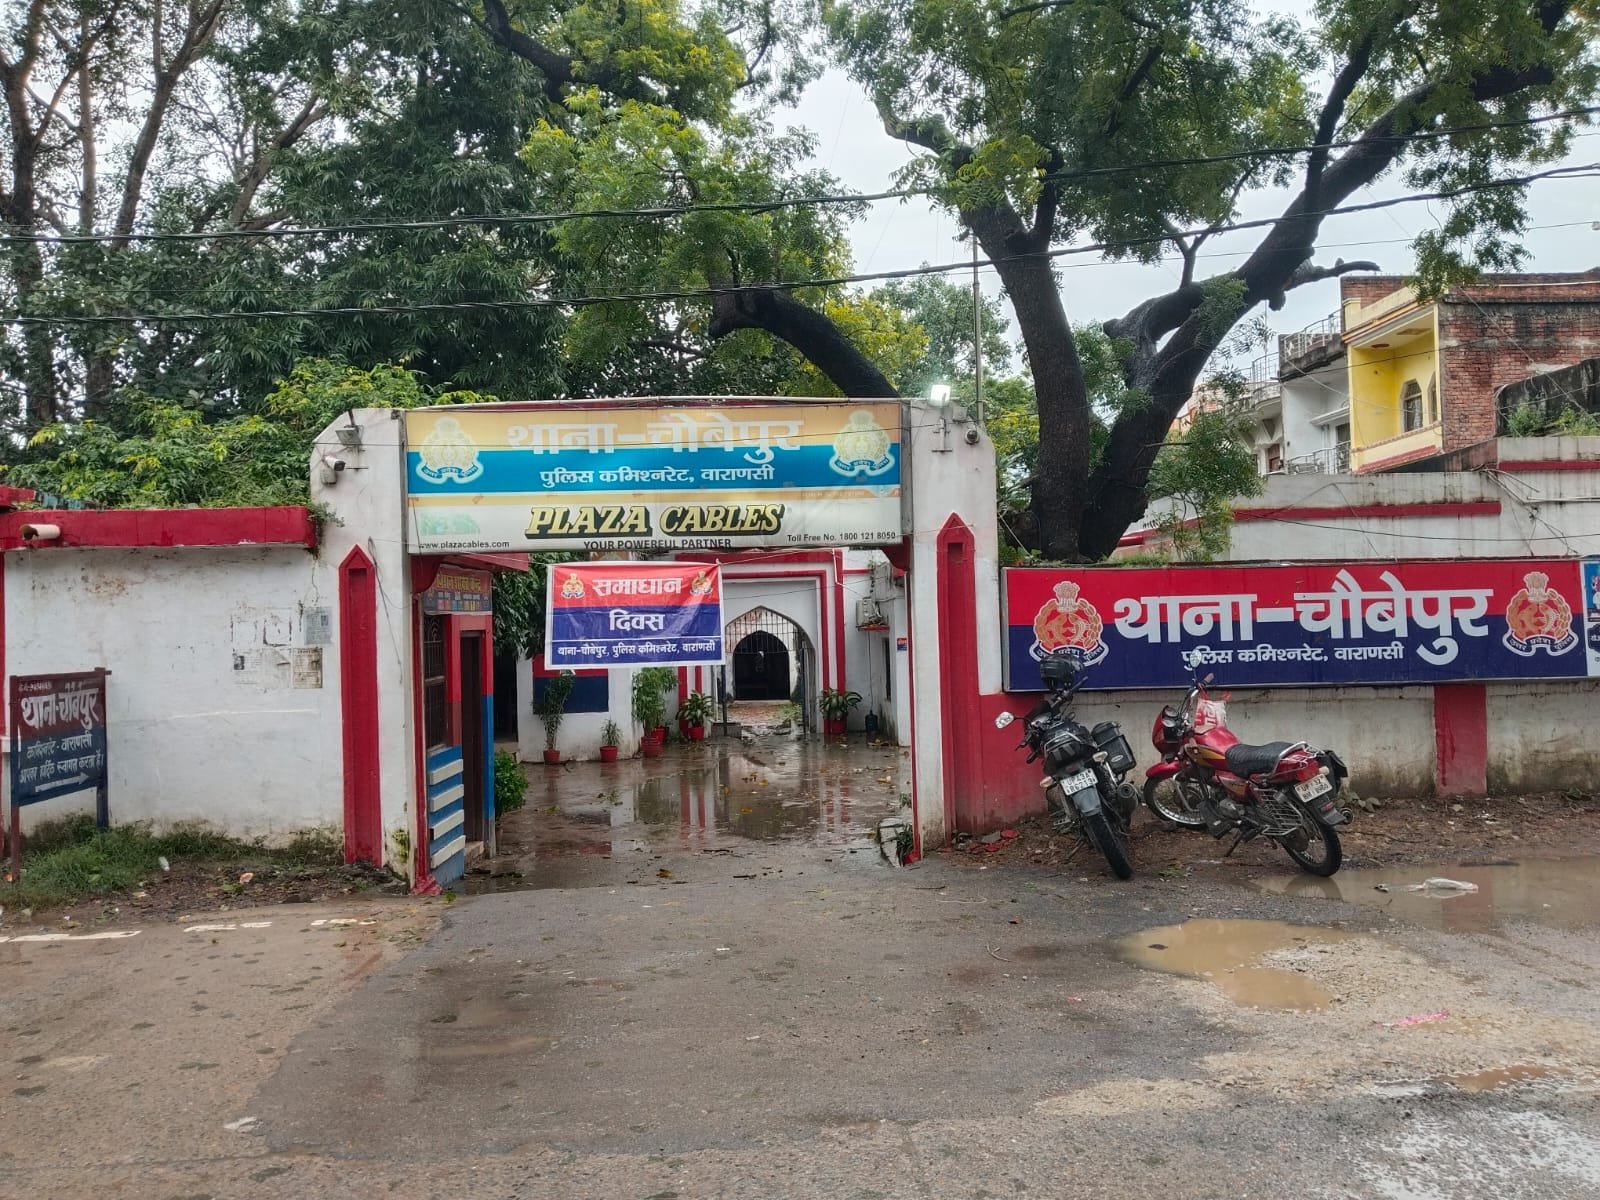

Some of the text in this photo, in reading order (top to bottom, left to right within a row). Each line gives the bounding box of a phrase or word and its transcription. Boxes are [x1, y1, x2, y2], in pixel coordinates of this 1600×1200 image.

[506, 412, 804, 464] थाना-चौबेपुर
[539, 463, 775, 488] पुलिस कमिश्नरेट, वाराणसी
[525, 503, 786, 539] PLAZA CABLES
[419, 540, 510, 549] www.plazacables.com
[584, 540, 616, 550] YOUR
[682, 539, 732, 549] PARTNER
[787, 531, 896, 542] Toll Free No. 1800 121 8050
[592, 578, 683, 597] समाधान
[609, 608, 665, 631] दिवस
[1114, 568, 1494, 666] थाना-चौबेपुर
[557, 640, 716, 658] थाना-चौबेपुर, पुलिस कमिश्नरेट, वाराणसी
[1238, 643, 1328, 664] कमिश्नरेट,
[1334, 641, 1404, 660] वाराणसी
